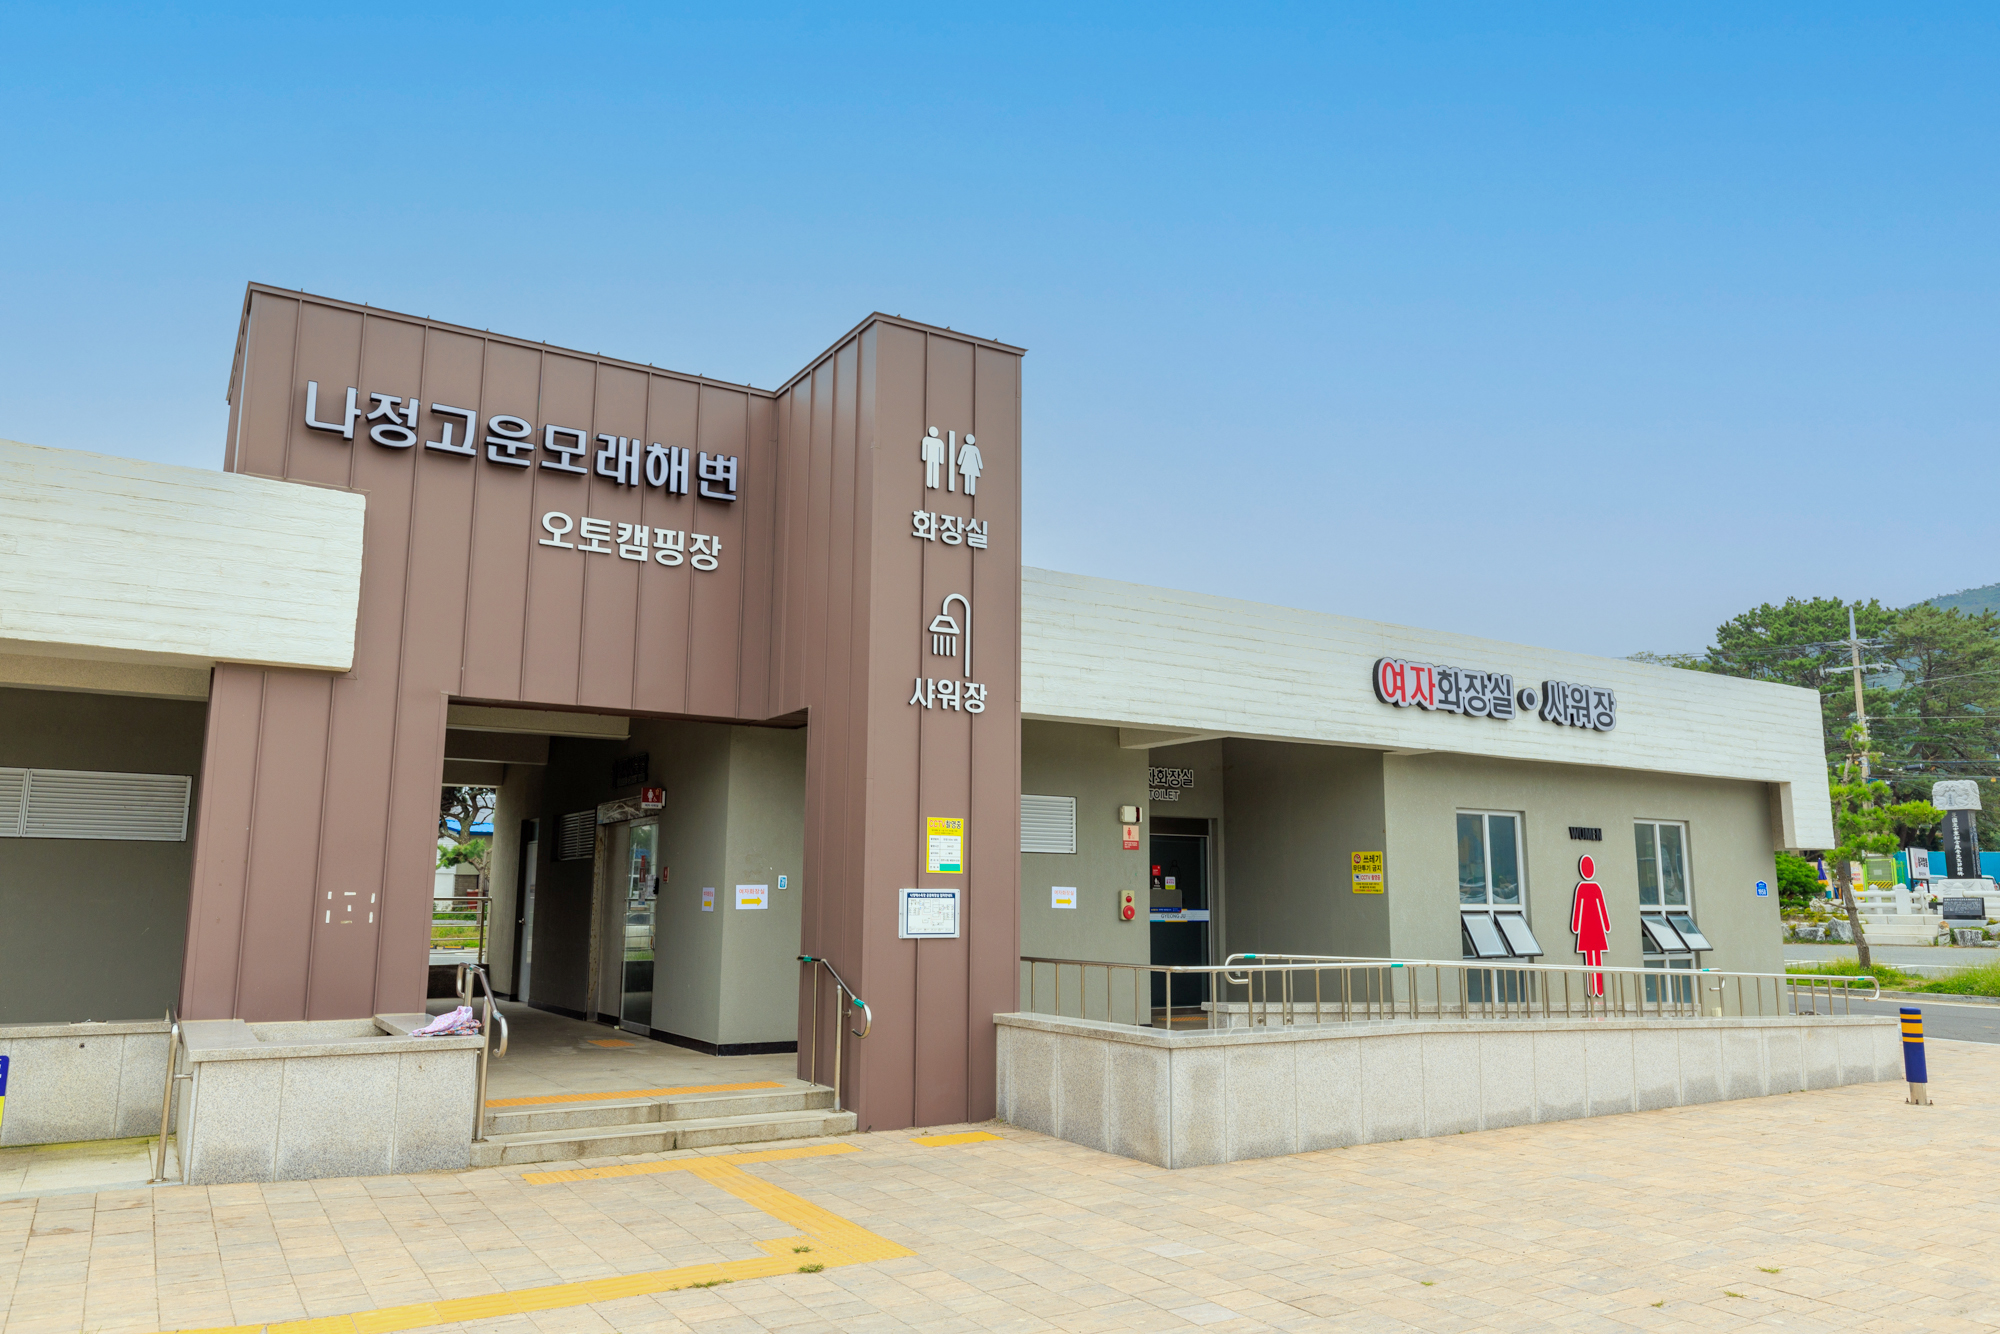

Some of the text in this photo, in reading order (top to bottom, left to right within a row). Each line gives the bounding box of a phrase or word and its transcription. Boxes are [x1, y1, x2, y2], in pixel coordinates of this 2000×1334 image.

[305, 380, 738, 503] 나정고운모래해변
[539, 510, 722, 572] 오토캠핑장
[912, 510, 988, 549] 화장실
[909, 677, 988, 714] 샤워장
[1544, 680, 1616, 730] 샤워장
[1569, 827, 1602, 841] WOMEN
[1363, 854, 1381, 863] 쓰레기
[1372, 864, 1381, 872] 금지
